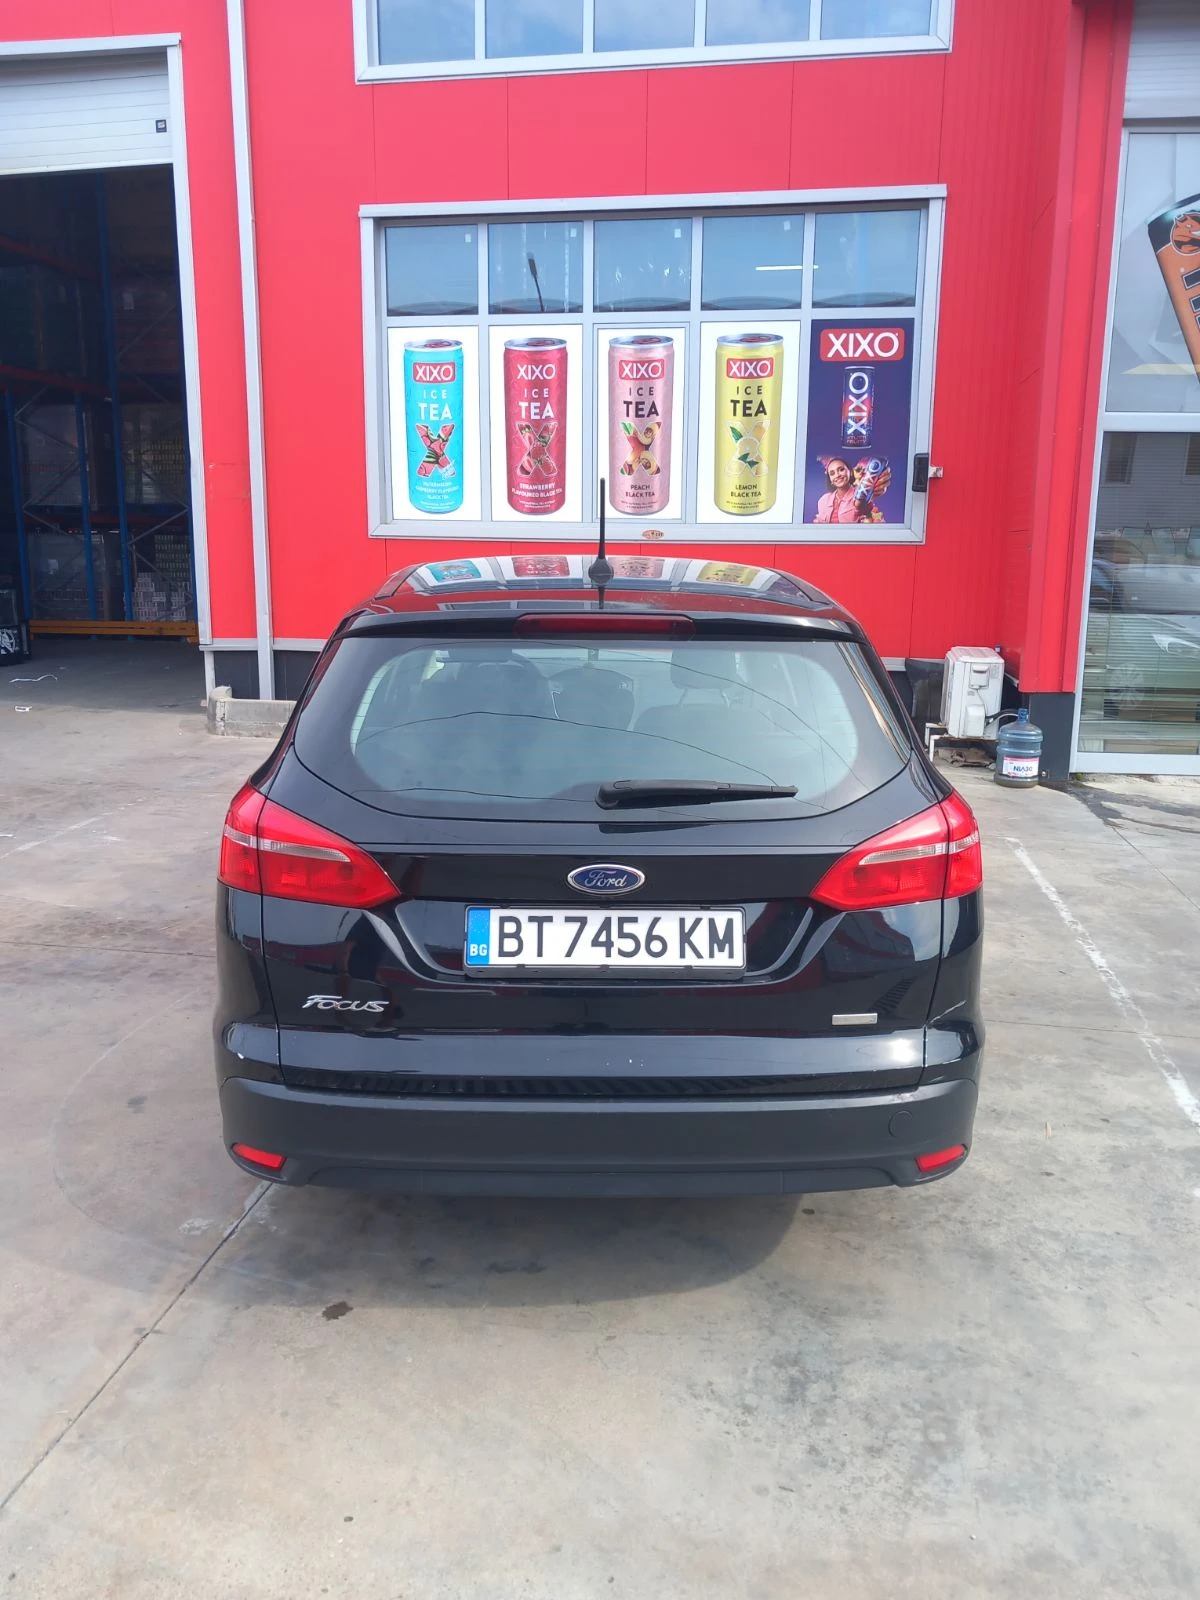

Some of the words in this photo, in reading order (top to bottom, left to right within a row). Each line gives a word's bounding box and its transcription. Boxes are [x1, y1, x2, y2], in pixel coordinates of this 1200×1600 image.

[827, 332, 899, 358] XIXO
[415, 365, 453, 381] XIXO
[516, 363, 556, 380] XIXO
[621, 361, 662, 379] XIXO
[729, 360, 771, 377] XIXO
[423, 389, 448, 399] ICE
[523, 387, 549, 398] ICE
[629, 386, 655, 397] ICE
[736, 385, 763, 396] ICE
[418, 402, 453, 421] TEA
[518, 401, 555, 420] TEA
[623, 400, 660, 418] TEA
[730, 399, 768, 417] TEA
[847, 372, 869, 435] XIXO
[511, 487, 540, 498] FLAVOURED
[519, 482, 556, 490] STRAWBERRY
[584, 869, 627, 888] Ford
[469, 944, 488, 957] BG
[498, 915, 554, 958] BT
[564, 916, 668, 958] 7456
[679, 917, 734, 959] KM
